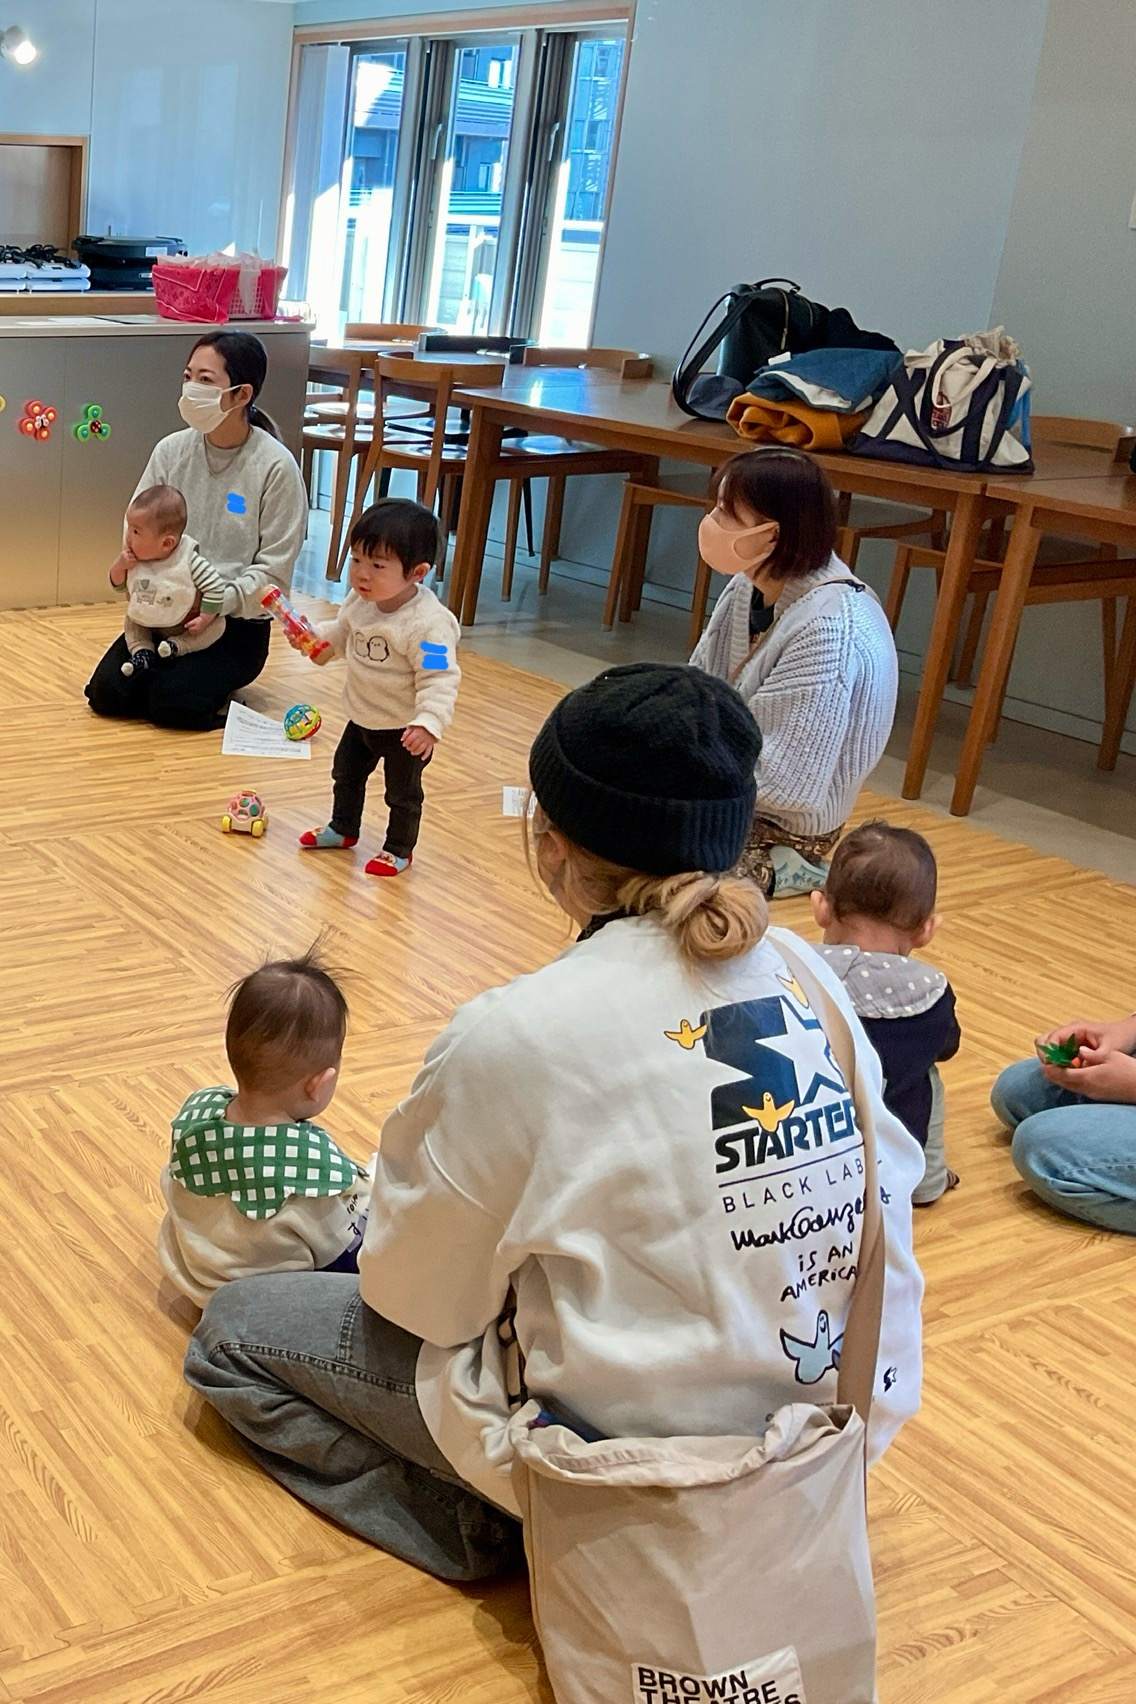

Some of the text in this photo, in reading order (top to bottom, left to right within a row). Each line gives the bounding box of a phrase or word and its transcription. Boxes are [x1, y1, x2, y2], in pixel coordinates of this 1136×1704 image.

[722, 1158, 882, 1213] BLACK LAB
[827, 1241, 853, 1263] AN
[780, 1265, 858, 1302] AMERiCA
[637, 1666, 749, 1699] BROWN
[639, 1679, 780, 1704] THRE
